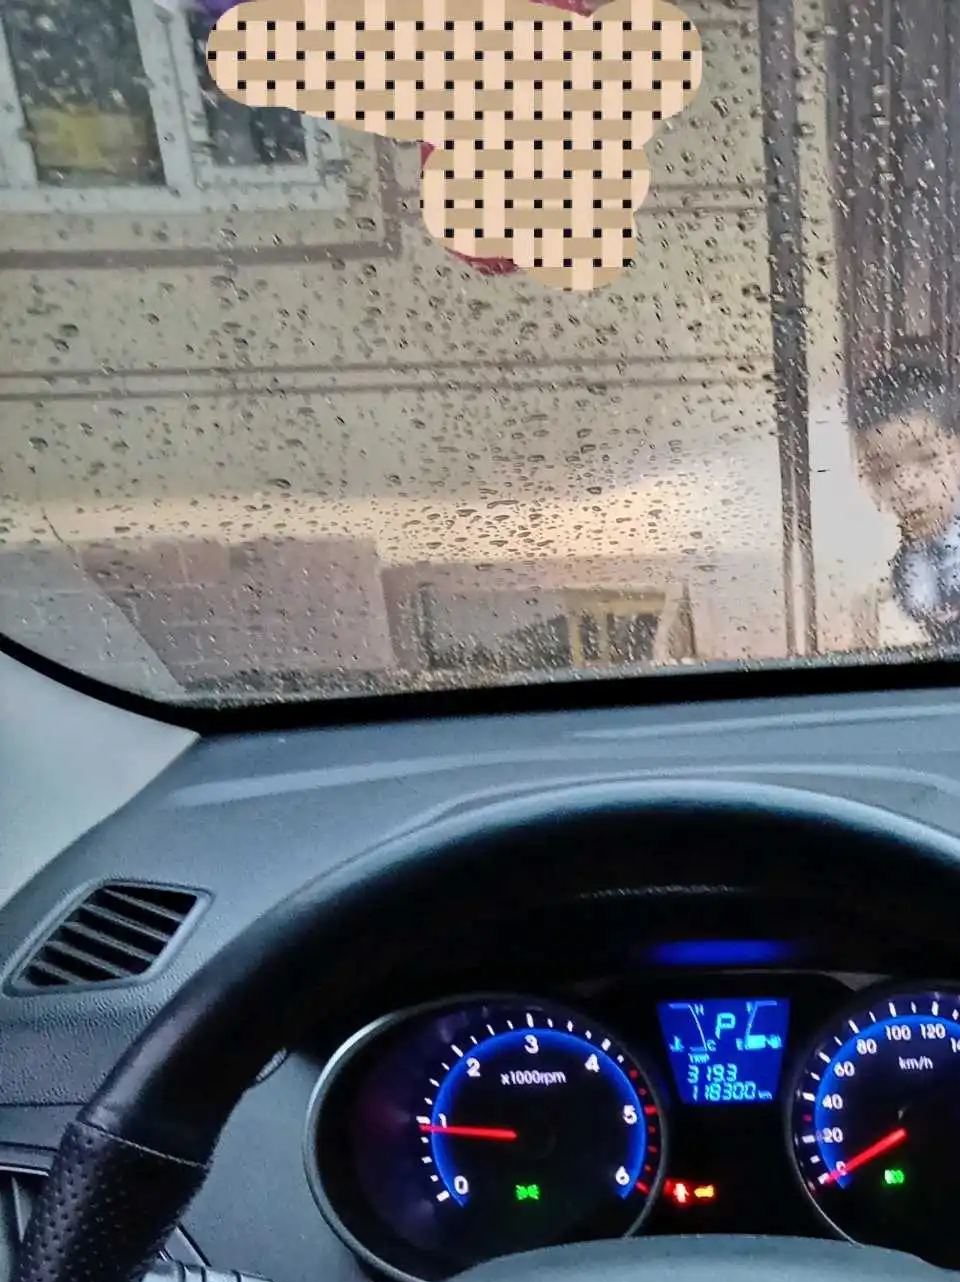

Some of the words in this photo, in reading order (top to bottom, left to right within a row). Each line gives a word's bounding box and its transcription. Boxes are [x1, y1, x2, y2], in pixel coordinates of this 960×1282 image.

[715, 1012, 736, 1040] P
[884, 1024, 912, 1041] 100
[920, 1023, 947, 1040] 120
[523, 1034, 539, 1054] 3
[856, 1038, 878, 1055] 80
[466, 1057, 481, 1078] 2
[584, 1053, 600, 1073] 4
[833, 1060, 856, 1077] 60
[898, 1056, 934, 1071] km/h
[500, 1069, 568, 1087] x1000rpm
[823, 1094, 844, 1110] 40
[437, 1112, 448, 1129] 1
[622, 1104, 638, 1125] 5
[822, 1126, 844, 1143] 20
[614, 1165, 630, 1186] 6
[453, 1175, 469, 1195] 0
